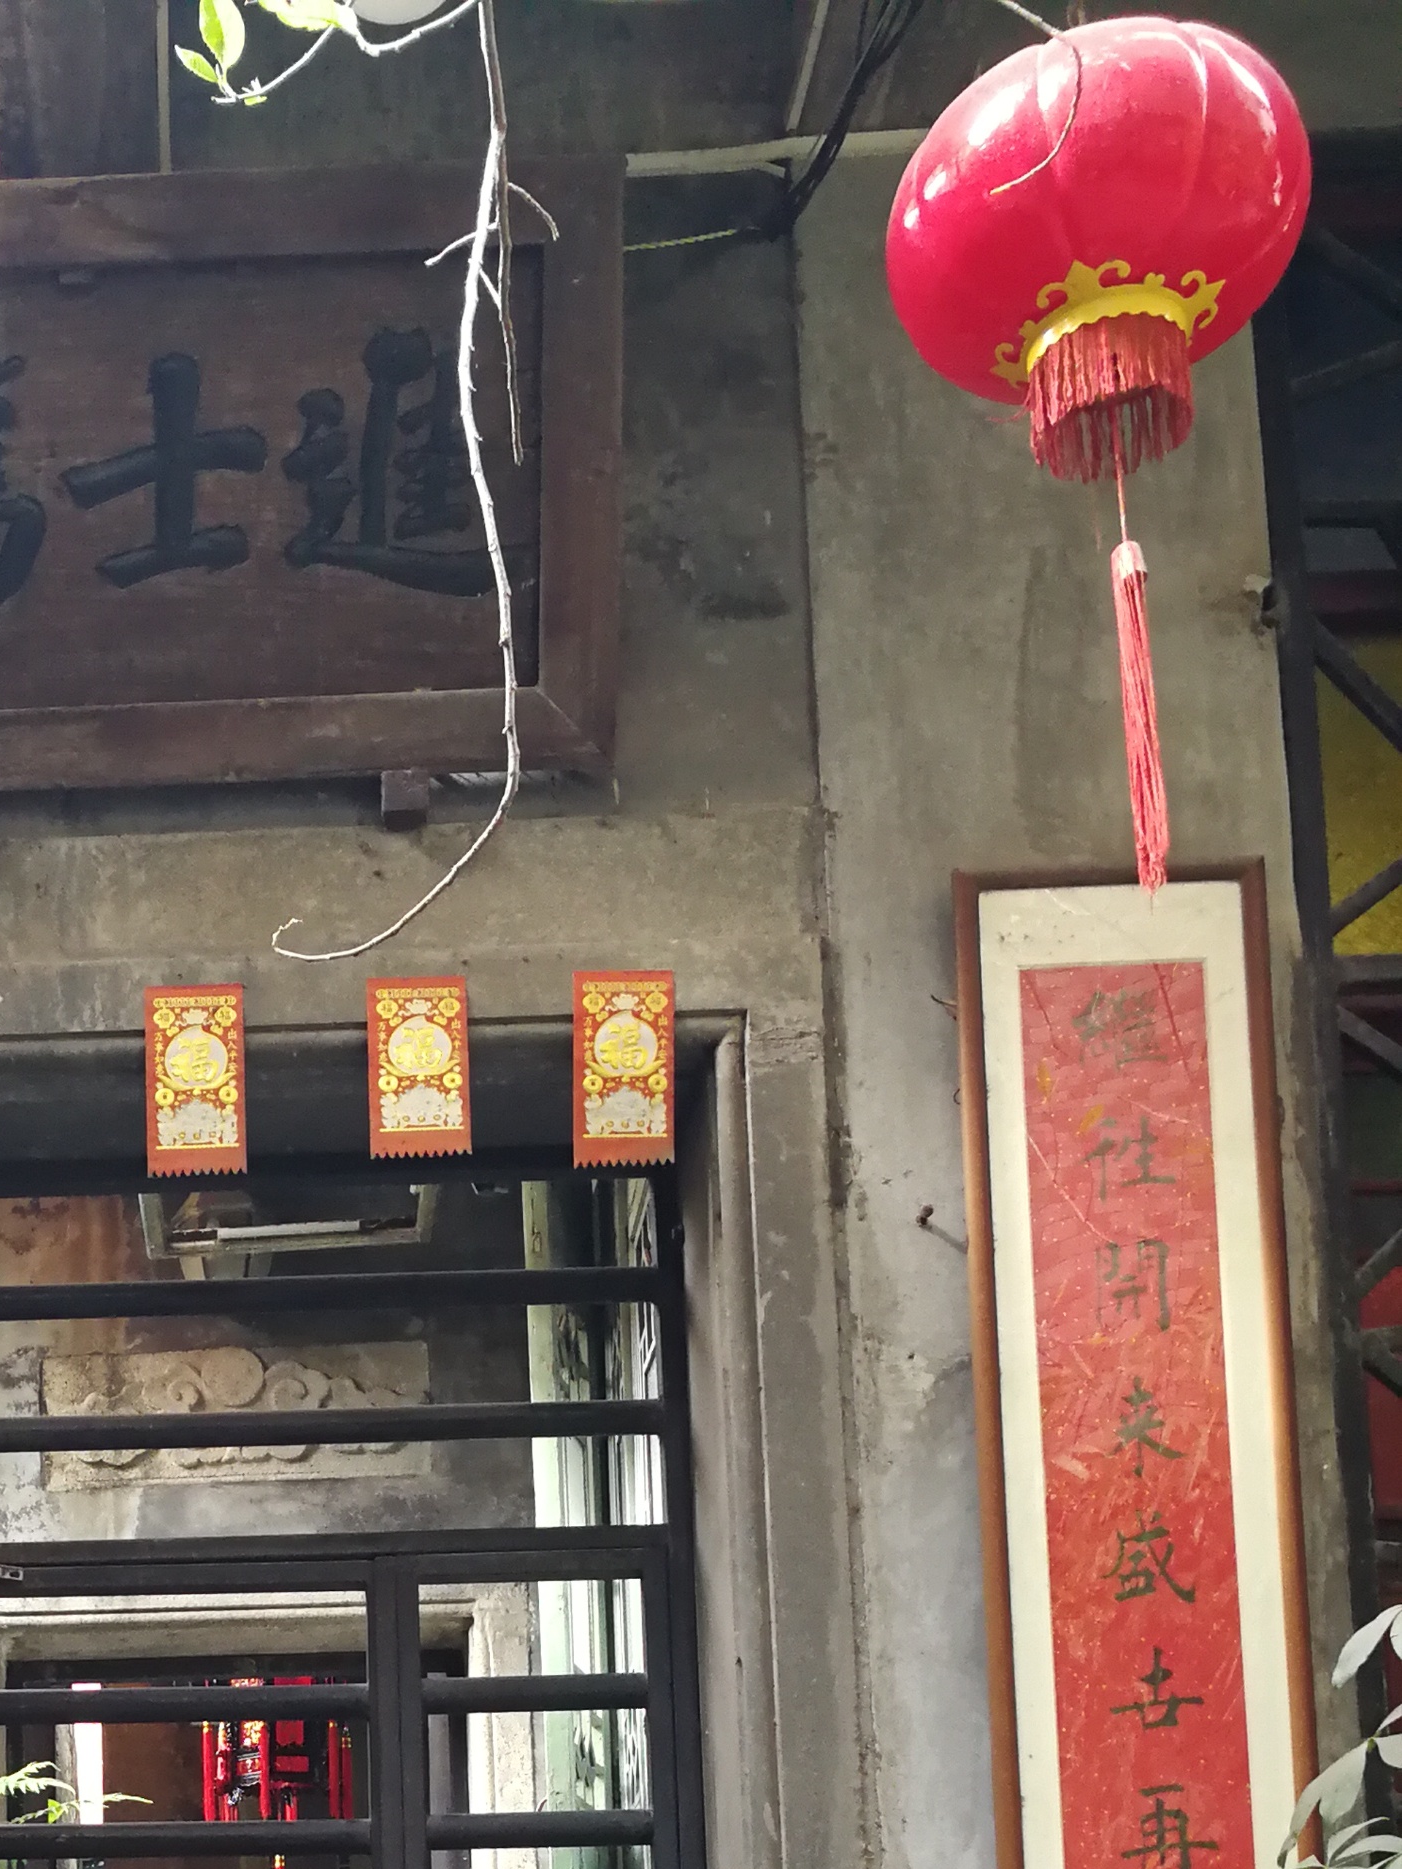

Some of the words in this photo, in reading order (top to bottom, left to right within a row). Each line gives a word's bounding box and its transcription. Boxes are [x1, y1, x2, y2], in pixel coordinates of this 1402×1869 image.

[170, 1037, 220, 1083] 福
[394, 1026, 443, 1069] 福
[599, 1022, 647, 1070] 福
